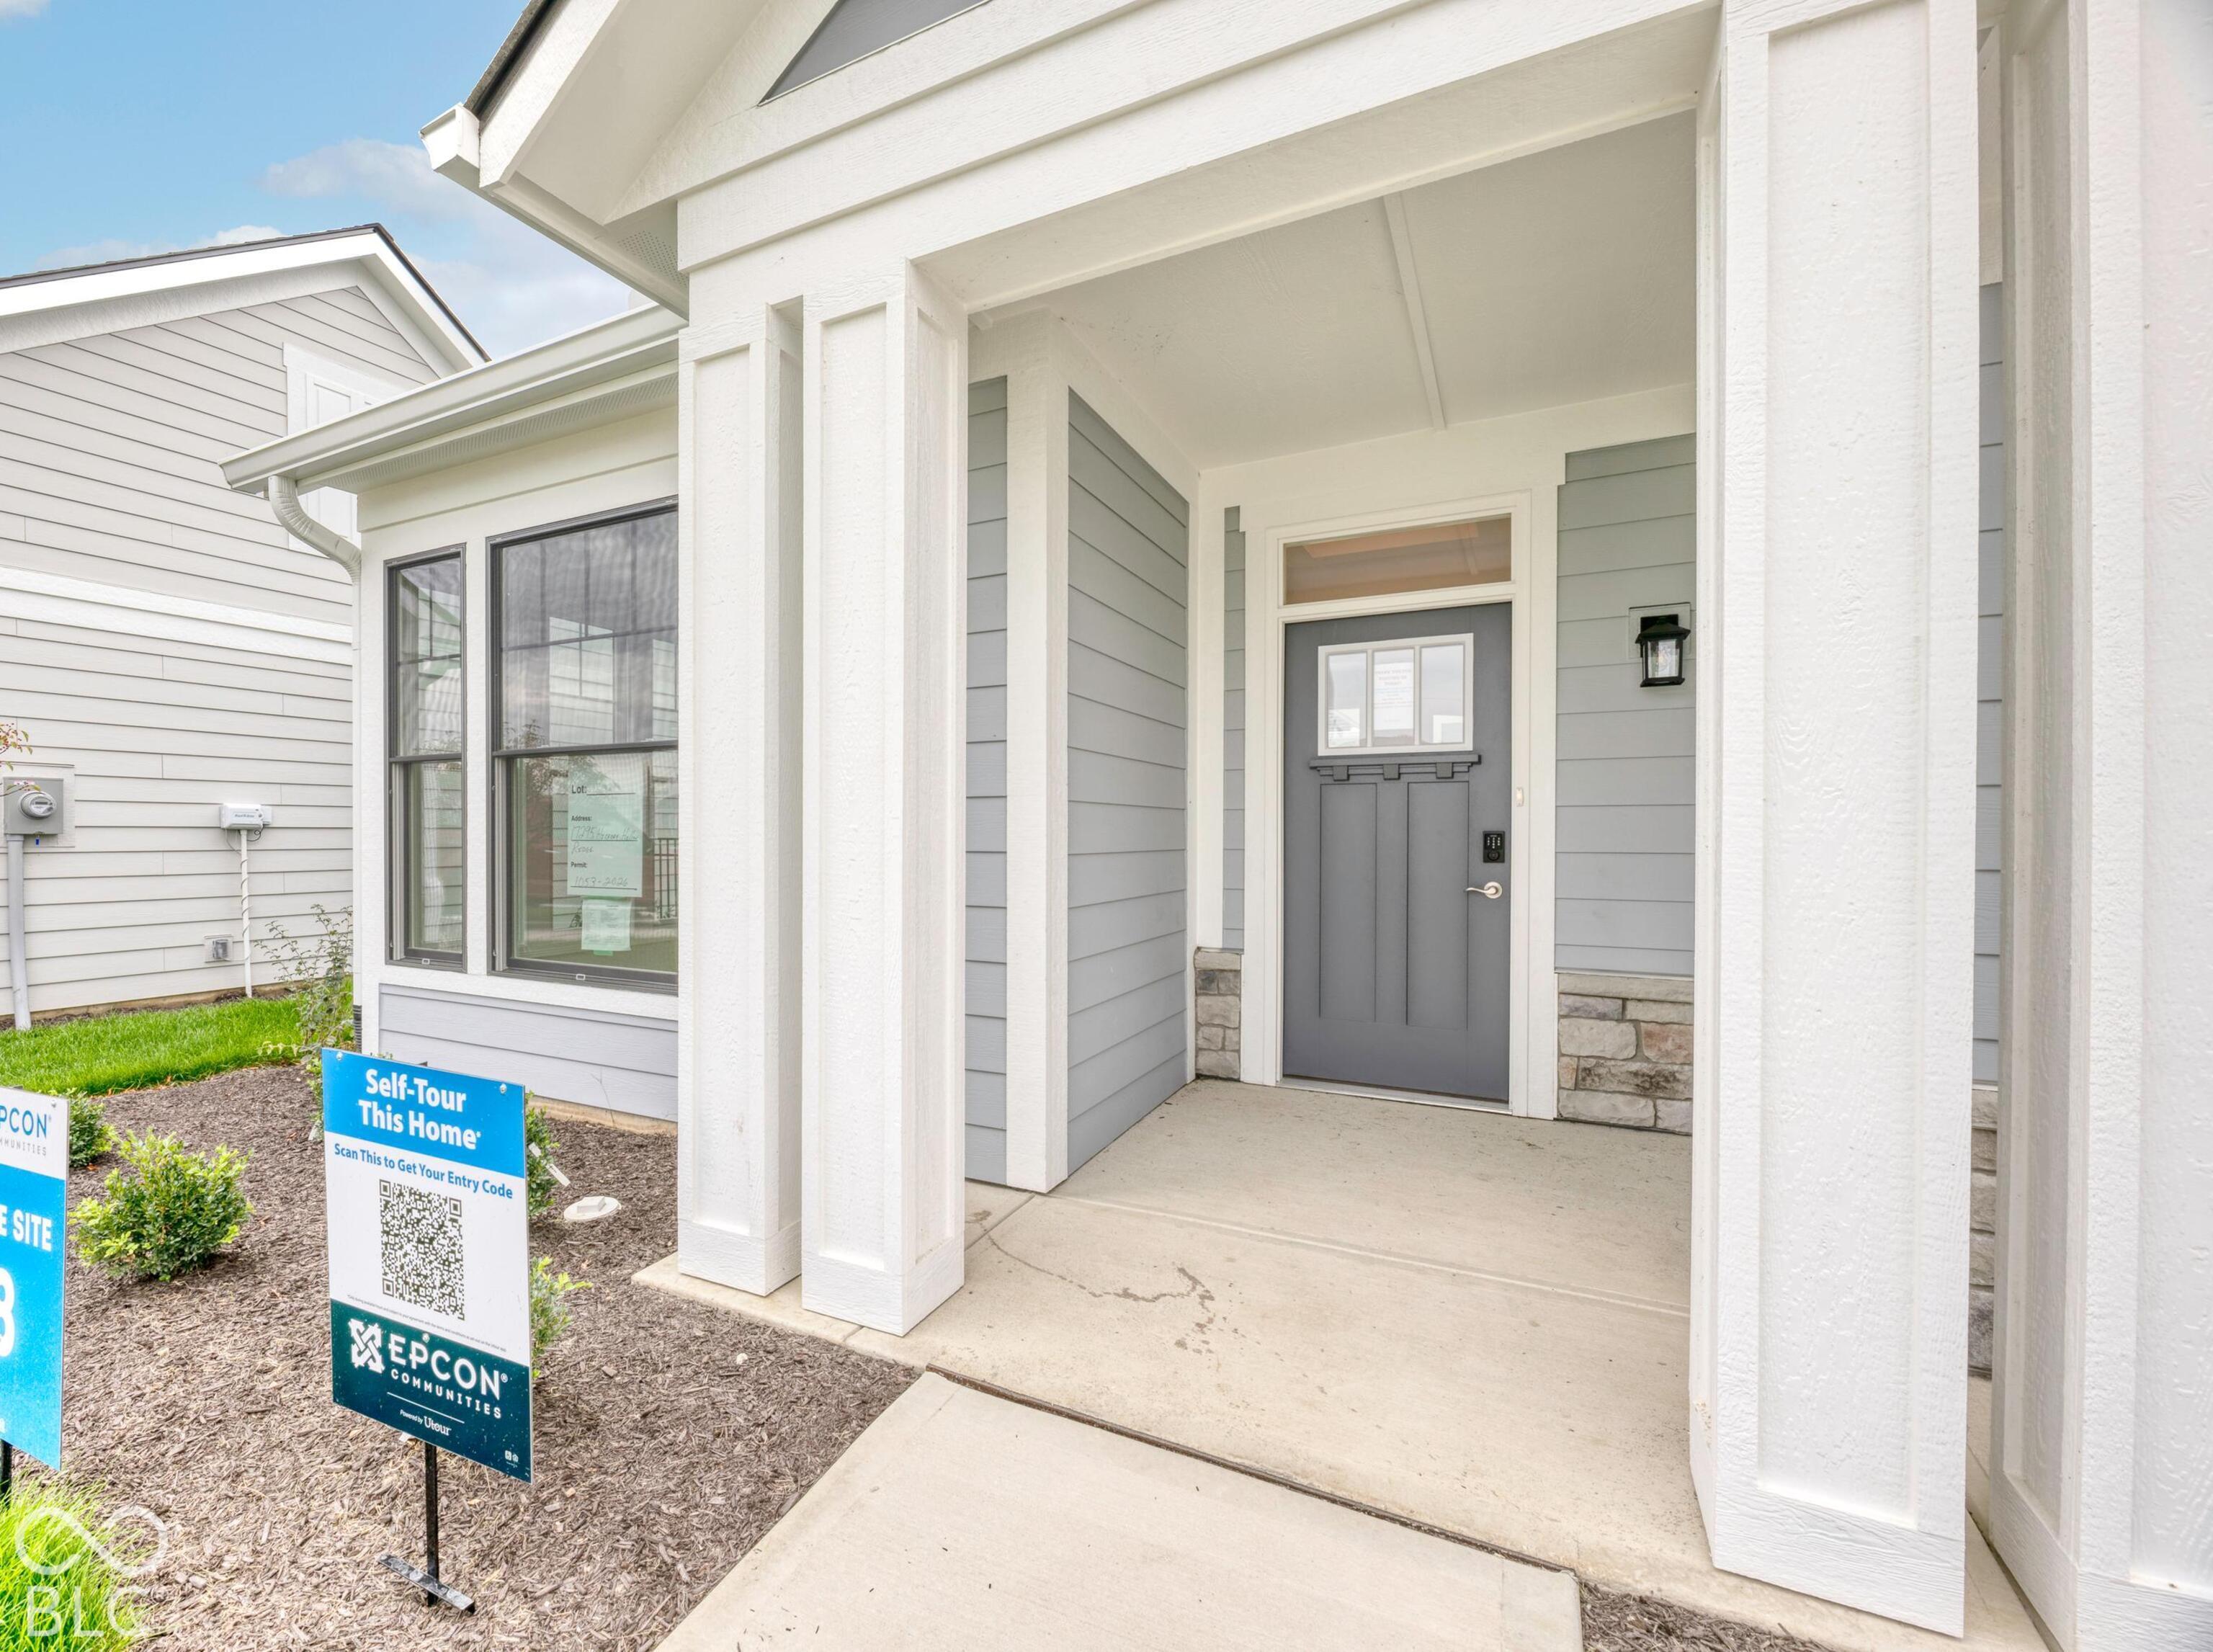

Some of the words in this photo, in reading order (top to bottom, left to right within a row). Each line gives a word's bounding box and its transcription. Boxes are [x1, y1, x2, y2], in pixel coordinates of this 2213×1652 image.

[571, 785, 587, 794] Lot:
[365, 1068, 467, 1113] Self-Tour
[358, 1100, 403, 1133] This
[334, 1143, 359, 1161] Scan
[360, 1148, 383, 1166] This
[385, 1156, 395, 1170] to
[398, 1158, 417, 1174] Get
[419, 1164, 445, 1182] Your
[448, 1171, 480, 1194] Entry
[482, 1179, 514, 1200] Code
[13, 1208, 52, 1252] SITE
[390, 1369, 502, 1419] COMMUNITIES
[400, 1409, 418, 1421] Powered
[418, 1416, 424, 1424] by
[424, 1416, 452, 1437] Utour
